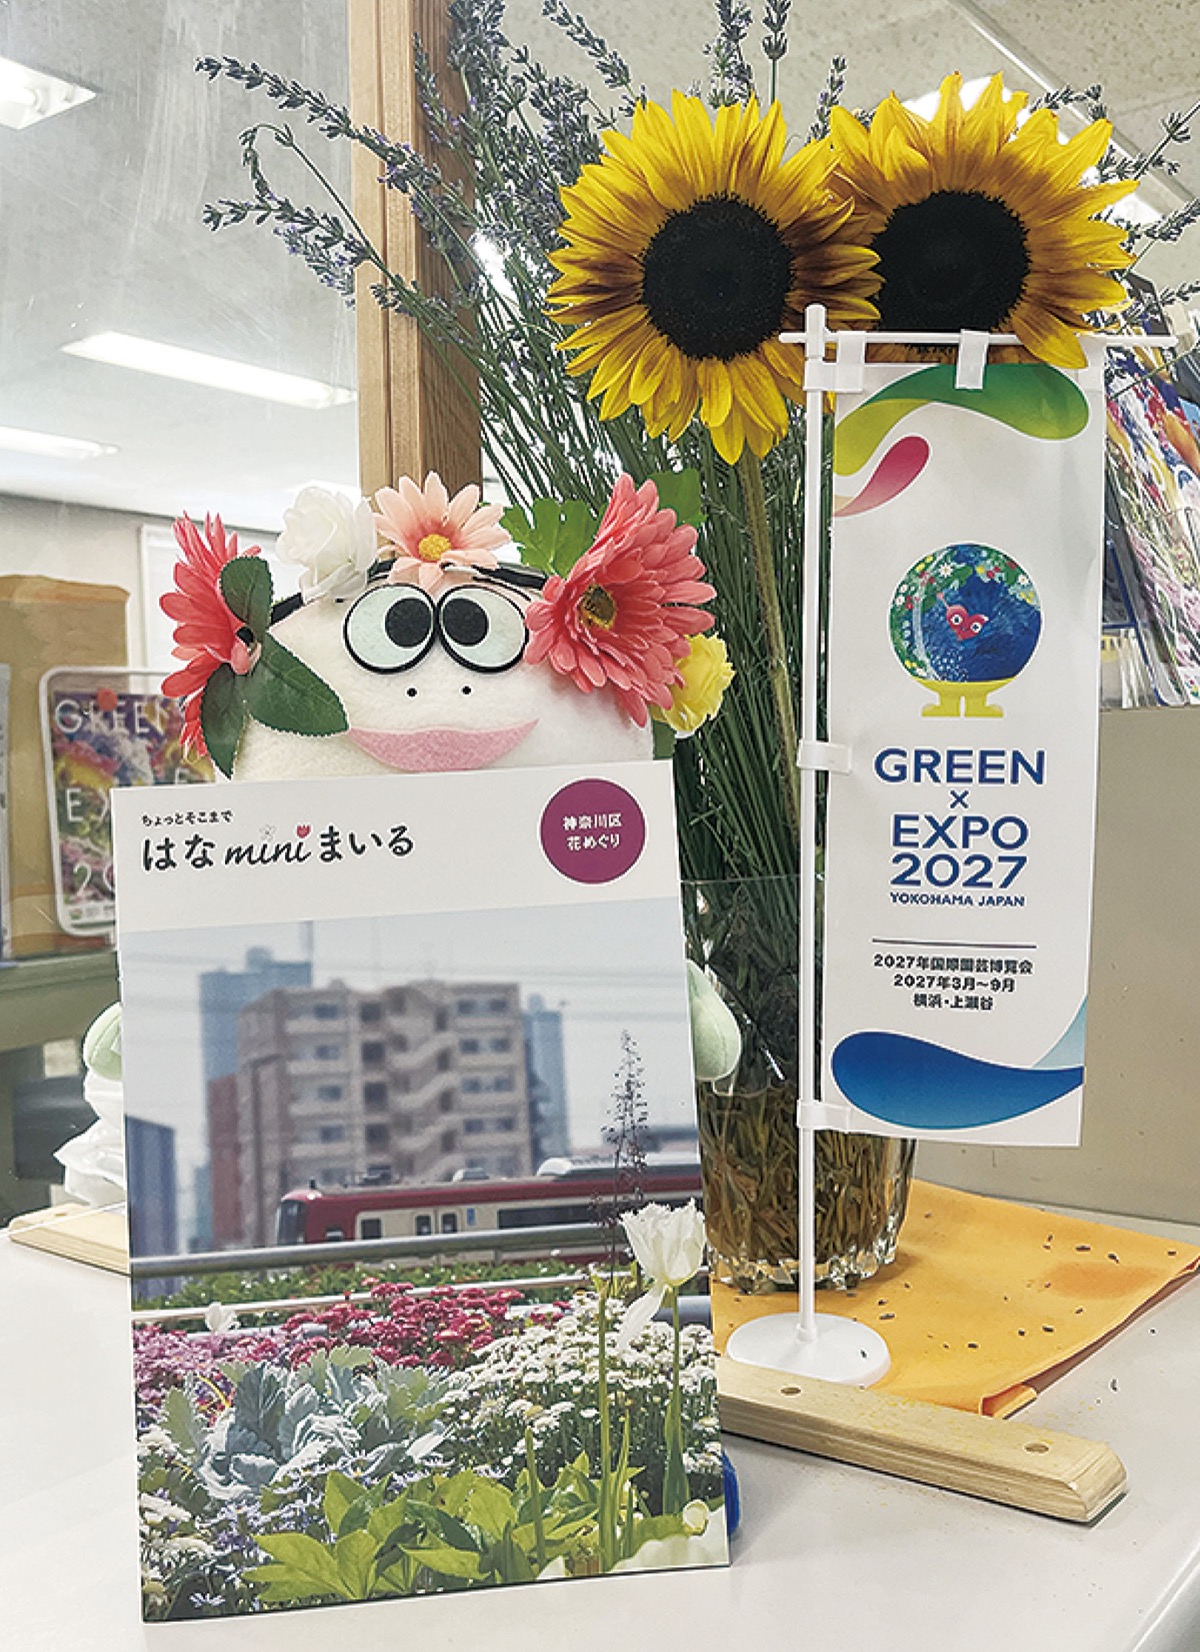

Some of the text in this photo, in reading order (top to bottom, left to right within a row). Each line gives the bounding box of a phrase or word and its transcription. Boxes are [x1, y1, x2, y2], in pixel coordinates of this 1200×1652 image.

[874, 748, 1045, 785] GREEN
[141, 809, 233, 827] ちょっとそこまで
[562, 813, 623, 831] 神奈川区
[892, 814, 1029, 850] EXPO
[566, 833, 620, 851] 花めぐり
[890, 852, 1028, 889] 2027
[890, 891, 1025, 907] YOKOHAMA JAPAN
[873, 954, 1034, 975] 2027年国際園芸博覧会
